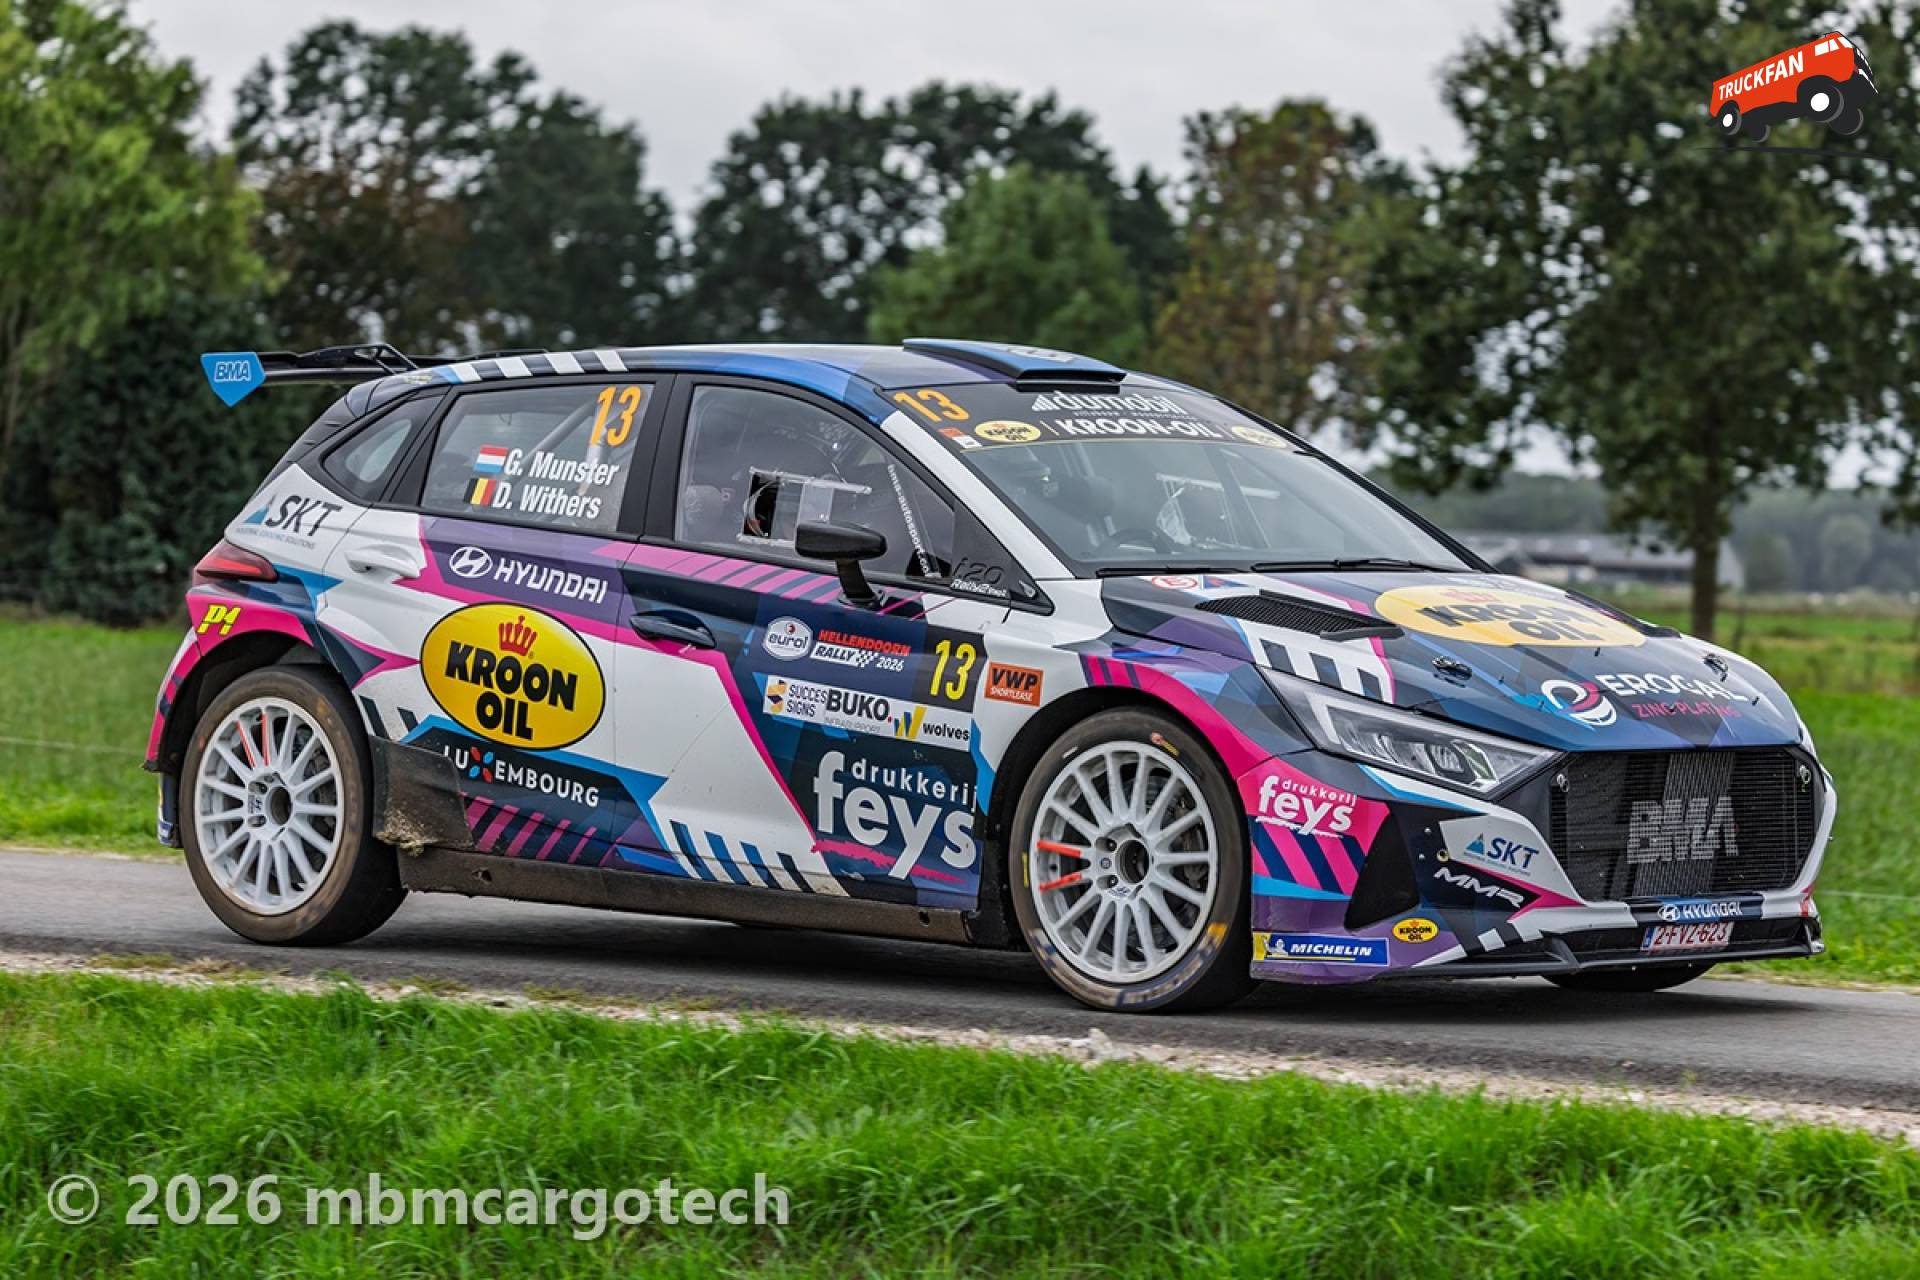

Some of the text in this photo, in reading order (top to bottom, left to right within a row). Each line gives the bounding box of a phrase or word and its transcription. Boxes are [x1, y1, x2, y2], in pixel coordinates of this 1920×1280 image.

[214, 360, 251, 382] BMA
[590, 385, 642, 447] 13
[892, 388, 970, 423] 13
[1054, 418, 1223, 439] KROON-OIL
[503, 448, 620, 486] G. Munster
[492, 482, 603, 519] D. Withers
[265, 495, 343, 536] SKT
[493, 557, 609, 604] HYUNDAI
[1416, 604, 1607, 628] KROON
[768, 633, 809, 649] eurol
[818, 629, 911, 657] HELLENDOORN
[1509, 620, 1603, 642] OIL
[815, 645, 855, 661] RALLY
[876, 657, 905, 672] 2026
[930, 639, 977, 700] 13
[444, 640, 579, 712] KROON
[992, 668, 1038, 691] VWP
[1595, 673, 1750, 701] EROGAL
[788, 684, 827, 704] SUCCES
[476, 691, 534, 741] OIL
[786, 700, 817, 718] SIGNS
[923, 722, 970, 741] wolves
[851, 758, 979, 812] drukkerij
[1282, 779, 1358, 807] drukkerij
[813, 750, 977, 881] feys
[1258, 775, 1354, 836] feys
[1627, 796, 1740, 865] BMA
[1486, 837, 1539, 869] SKT
[1433, 867, 1524, 908] MMR
[1683, 901, 1744, 919] HYUNDAI
[1399, 926, 1433, 935] KROON
[1290, 943, 1372, 957] MICHELIN
